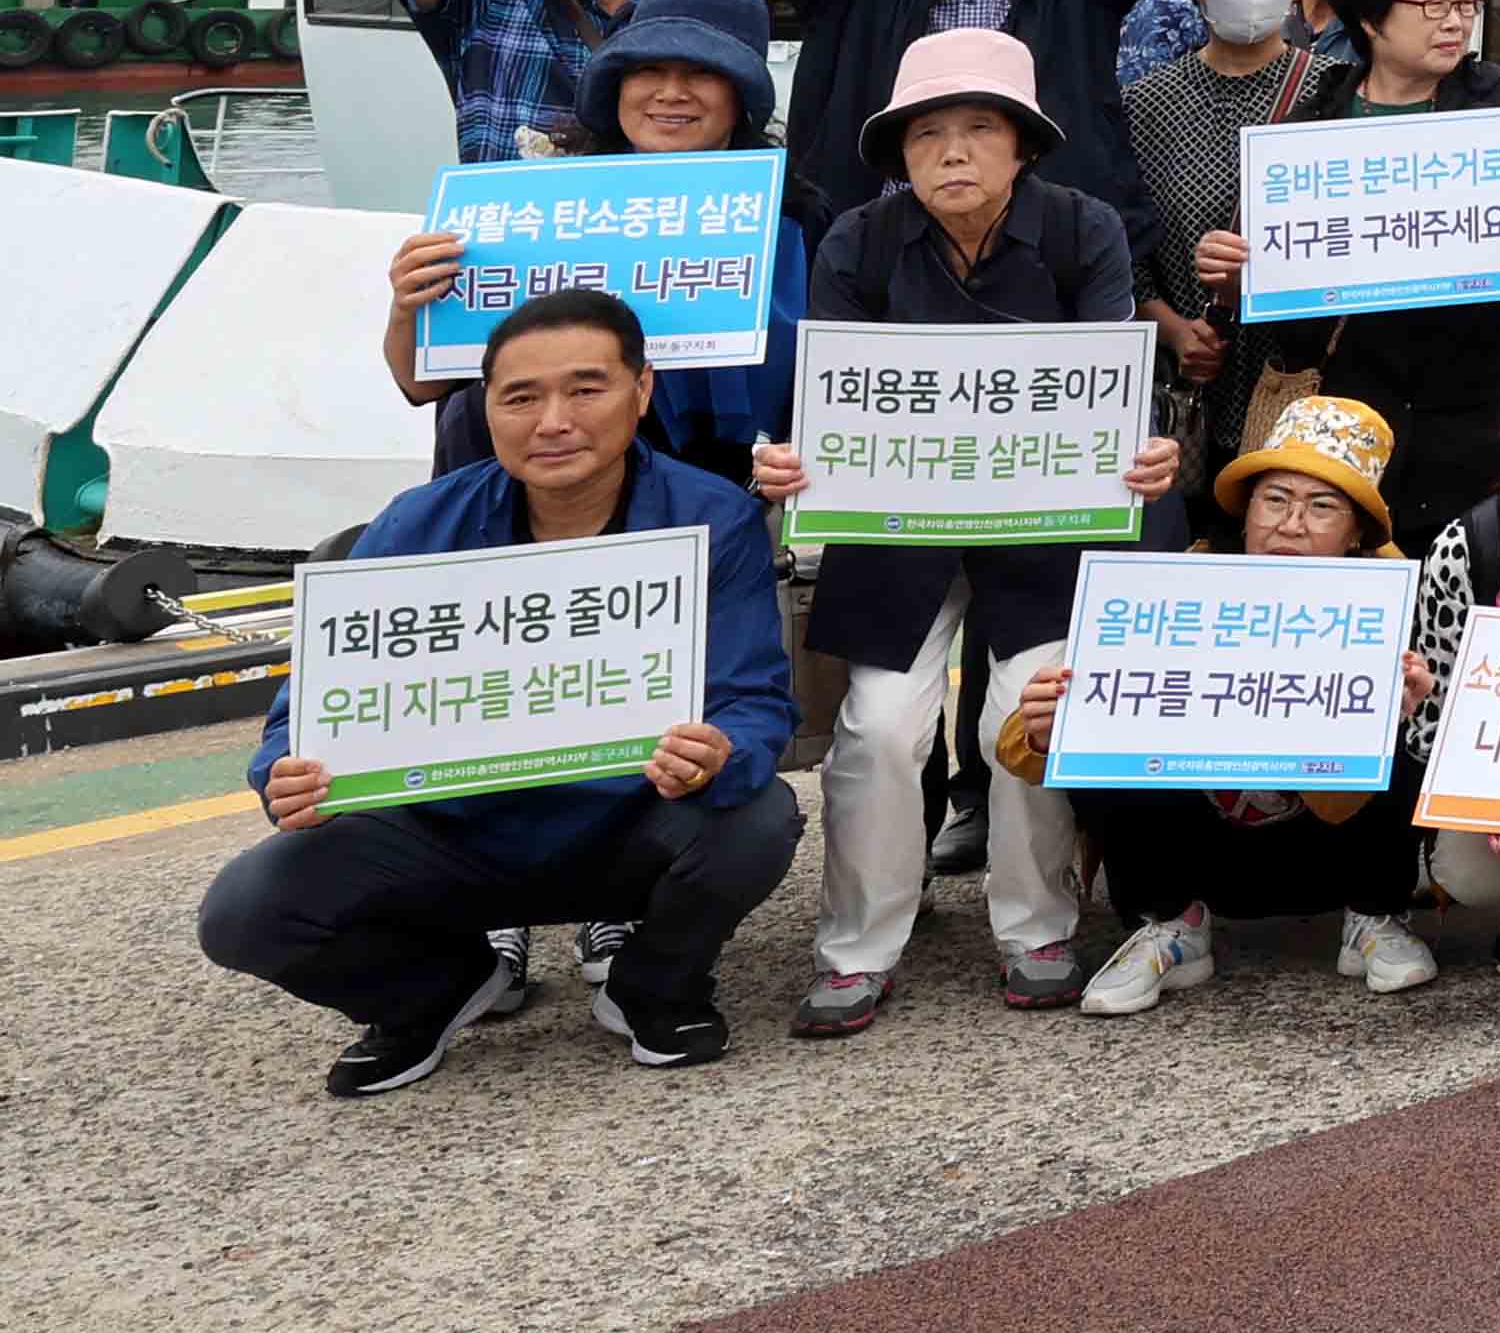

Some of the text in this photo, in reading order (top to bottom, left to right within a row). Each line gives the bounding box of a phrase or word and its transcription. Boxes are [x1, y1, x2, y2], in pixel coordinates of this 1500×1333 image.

[1263, 159, 1352, 204] 올바른
[554, 191, 763, 240] 탄소중립 실천
[1263, 217, 1353, 261] 지구를
[634, 255, 756, 302] 나부터
[819, 365, 1132, 414] 1회용품 사용 줄이기
[816, 429, 1120, 481] 우리 지구를 살리는 길
[319, 576, 682, 659] 1회용품 사용 줄이기
[1096, 598, 1385, 649] 올바른 분리수거로
[317, 649, 674, 739] 우리 지구를 살리는 길
[1085, 669, 1376, 719] 지구를 구해주세요
